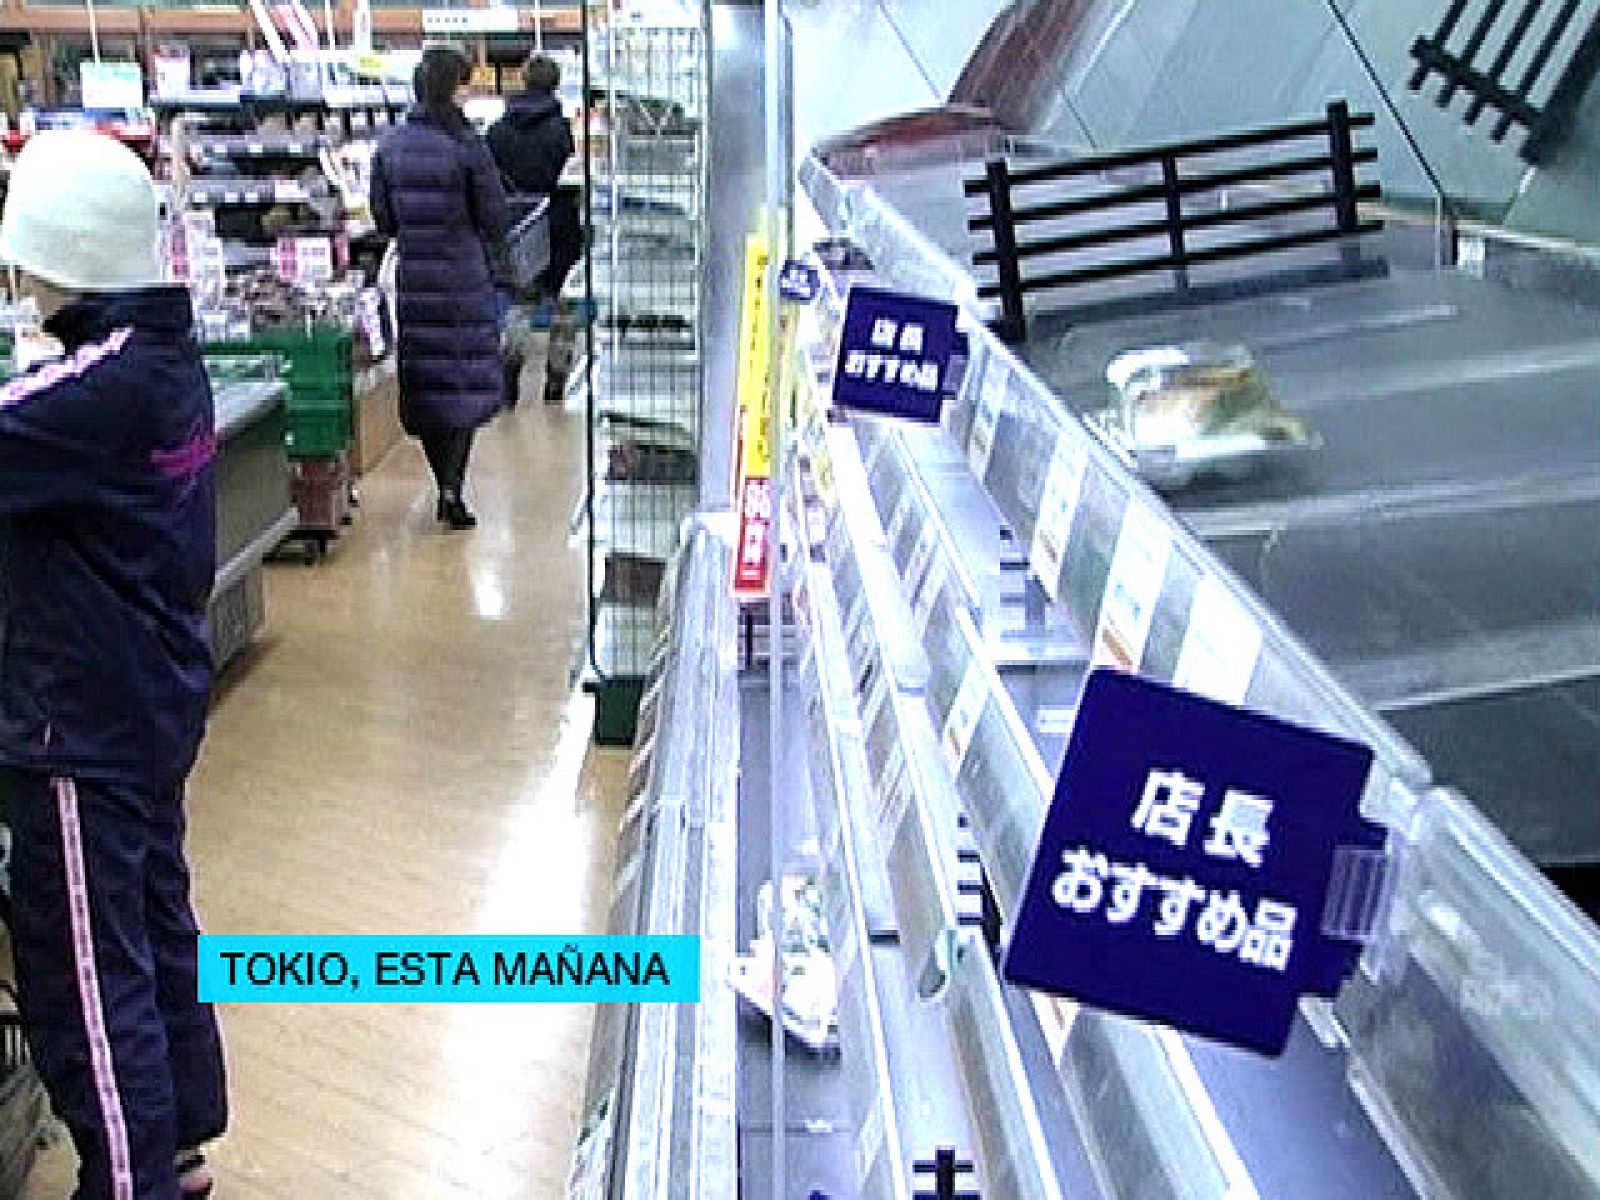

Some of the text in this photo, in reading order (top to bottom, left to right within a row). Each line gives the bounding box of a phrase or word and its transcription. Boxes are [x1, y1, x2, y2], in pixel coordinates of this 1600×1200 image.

[1131, 770, 1274, 869] 店長
[1052, 848, 1298, 972] おすすめ品
